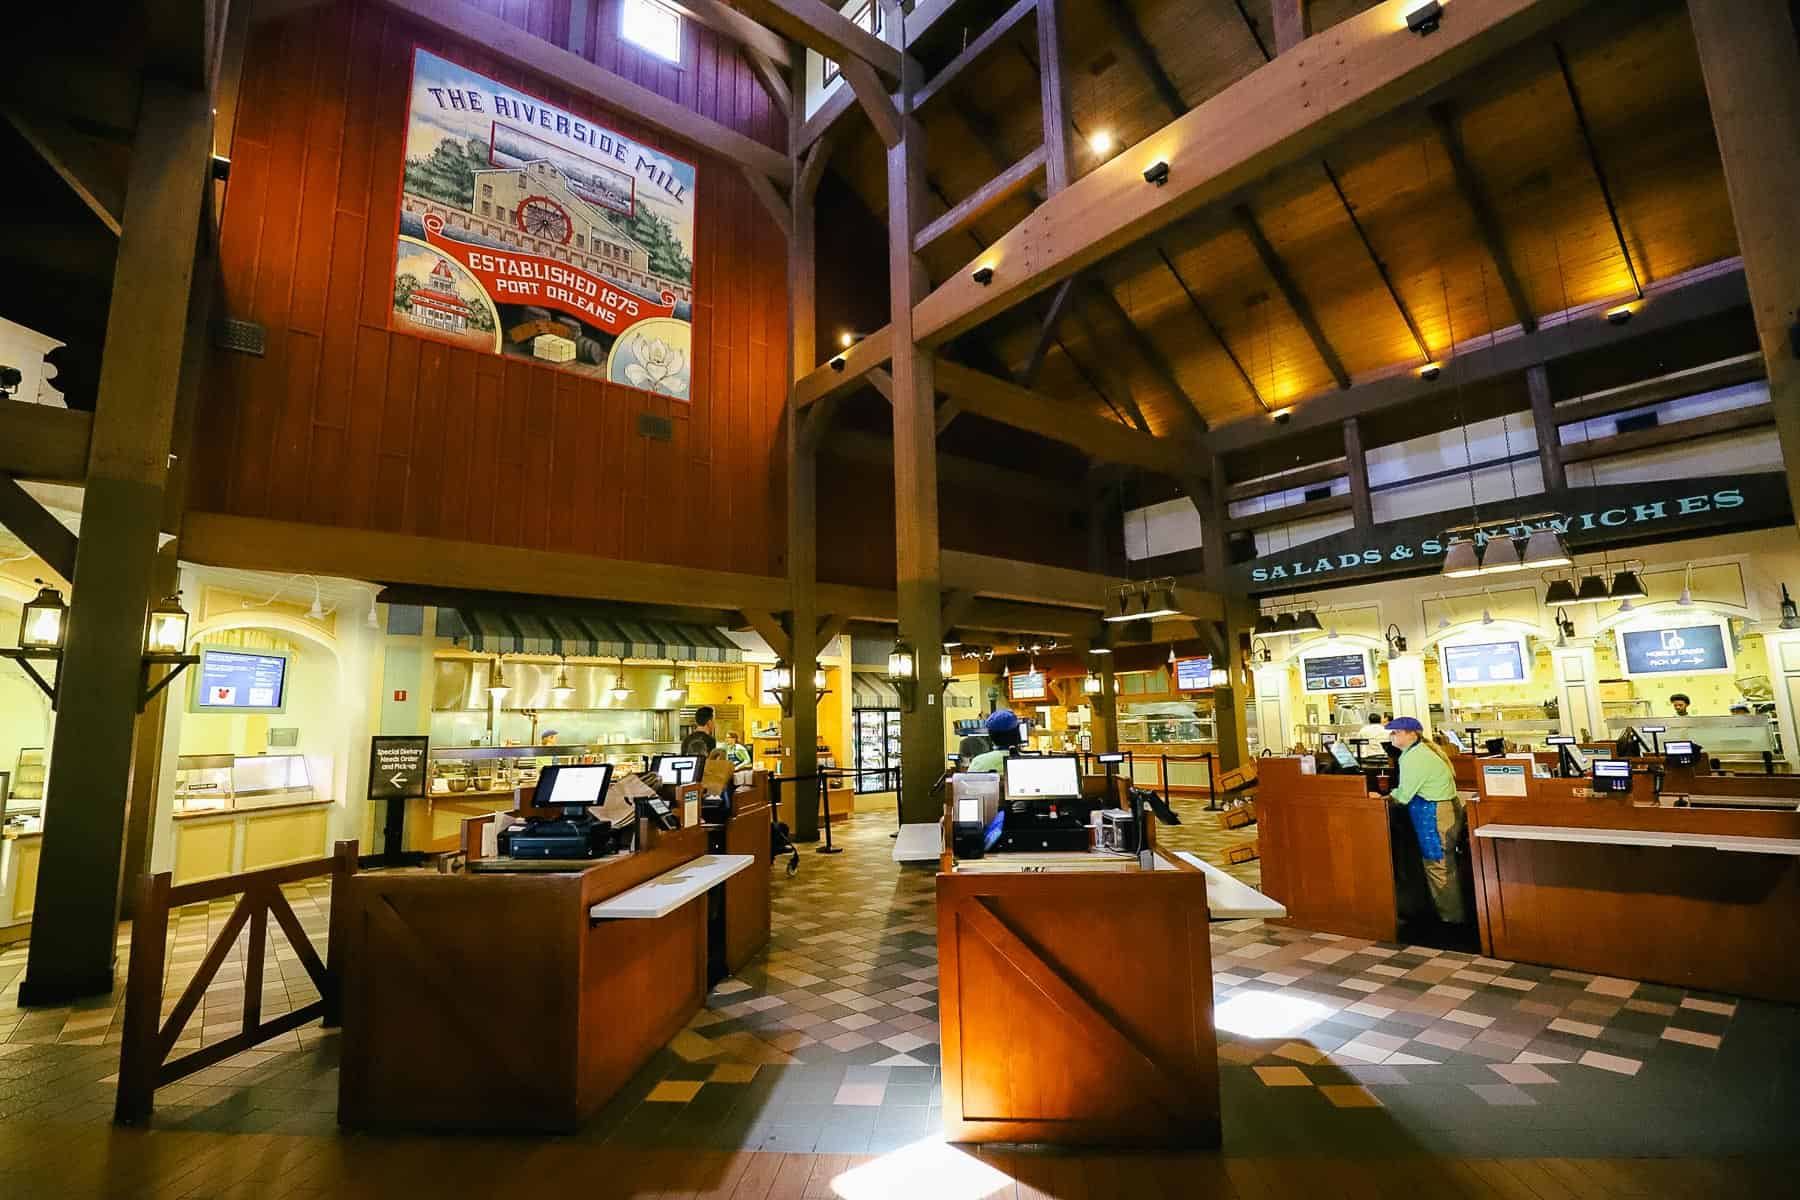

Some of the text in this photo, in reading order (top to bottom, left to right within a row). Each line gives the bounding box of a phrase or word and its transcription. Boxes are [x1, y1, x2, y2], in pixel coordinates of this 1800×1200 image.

[428, 87, 687, 206] THE RIVERSIDE MILL
[468, 252, 640, 318] ESTABLISHED 1875
[495, 278, 618, 326] PORT ORLEANS
[1252, 549, 1383, 582] SALADS
[1390, 544, 1414, 560] &
